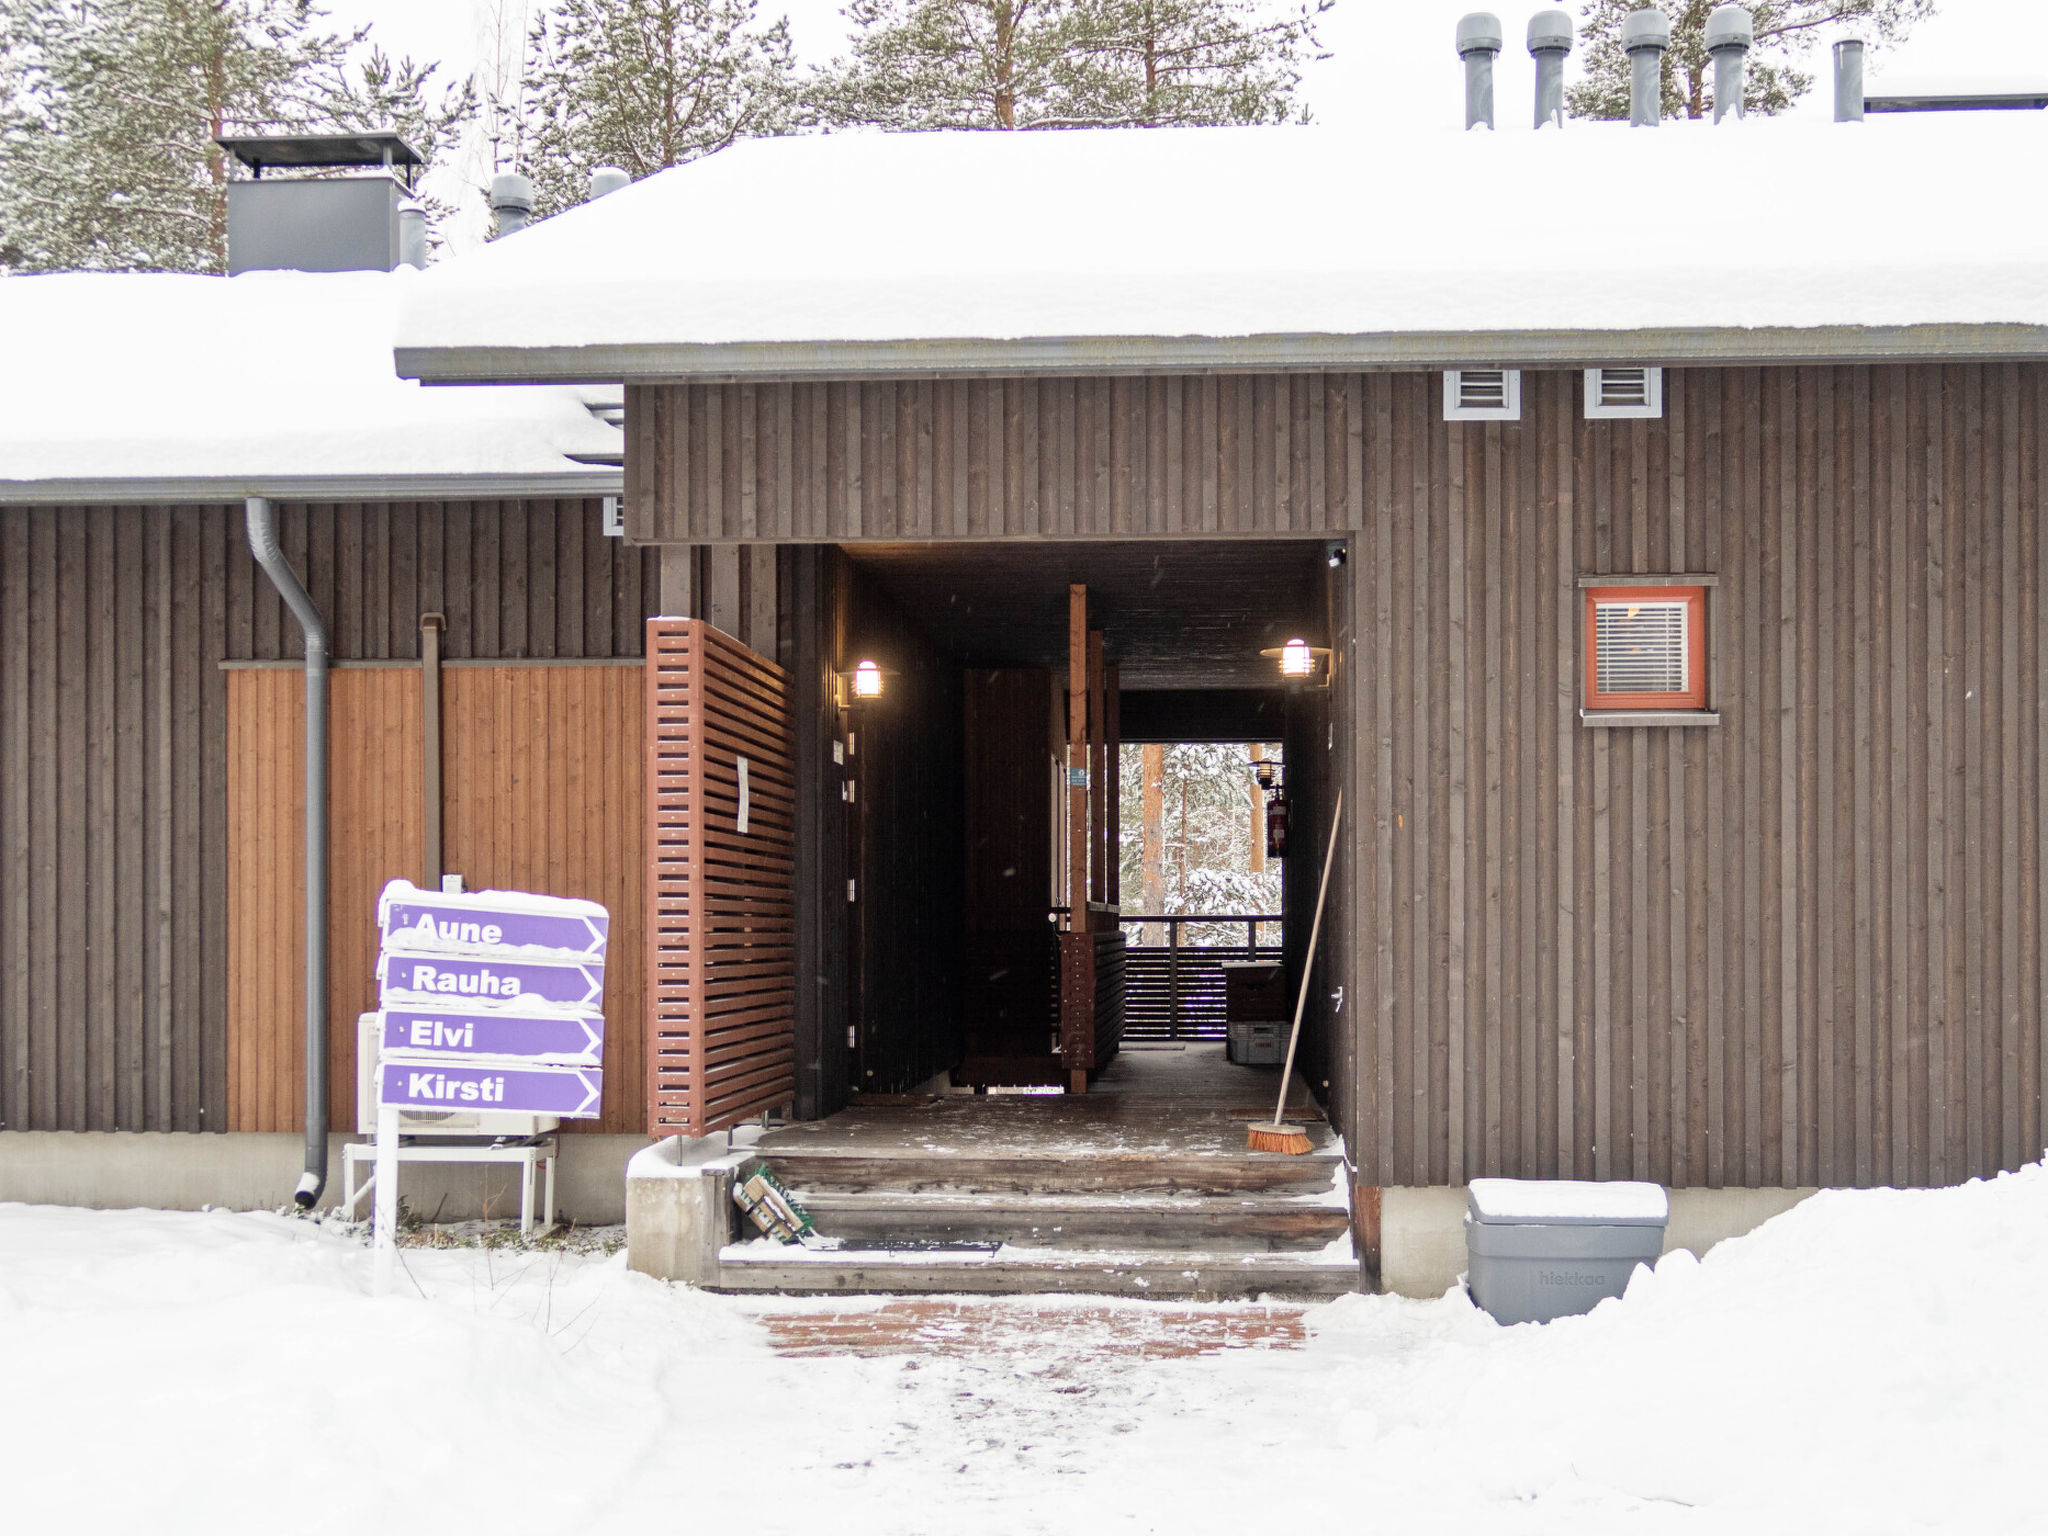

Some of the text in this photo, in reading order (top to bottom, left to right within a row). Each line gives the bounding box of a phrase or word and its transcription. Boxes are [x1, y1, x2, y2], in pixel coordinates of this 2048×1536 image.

[415, 913, 503, 944] Aune
[412, 965, 521, 996] Rauha
[410, 1020, 474, 1047] Elvi
[408, 1073, 505, 1102] Kirsti
[1539, 1271, 1605, 1286] hiekkaa
